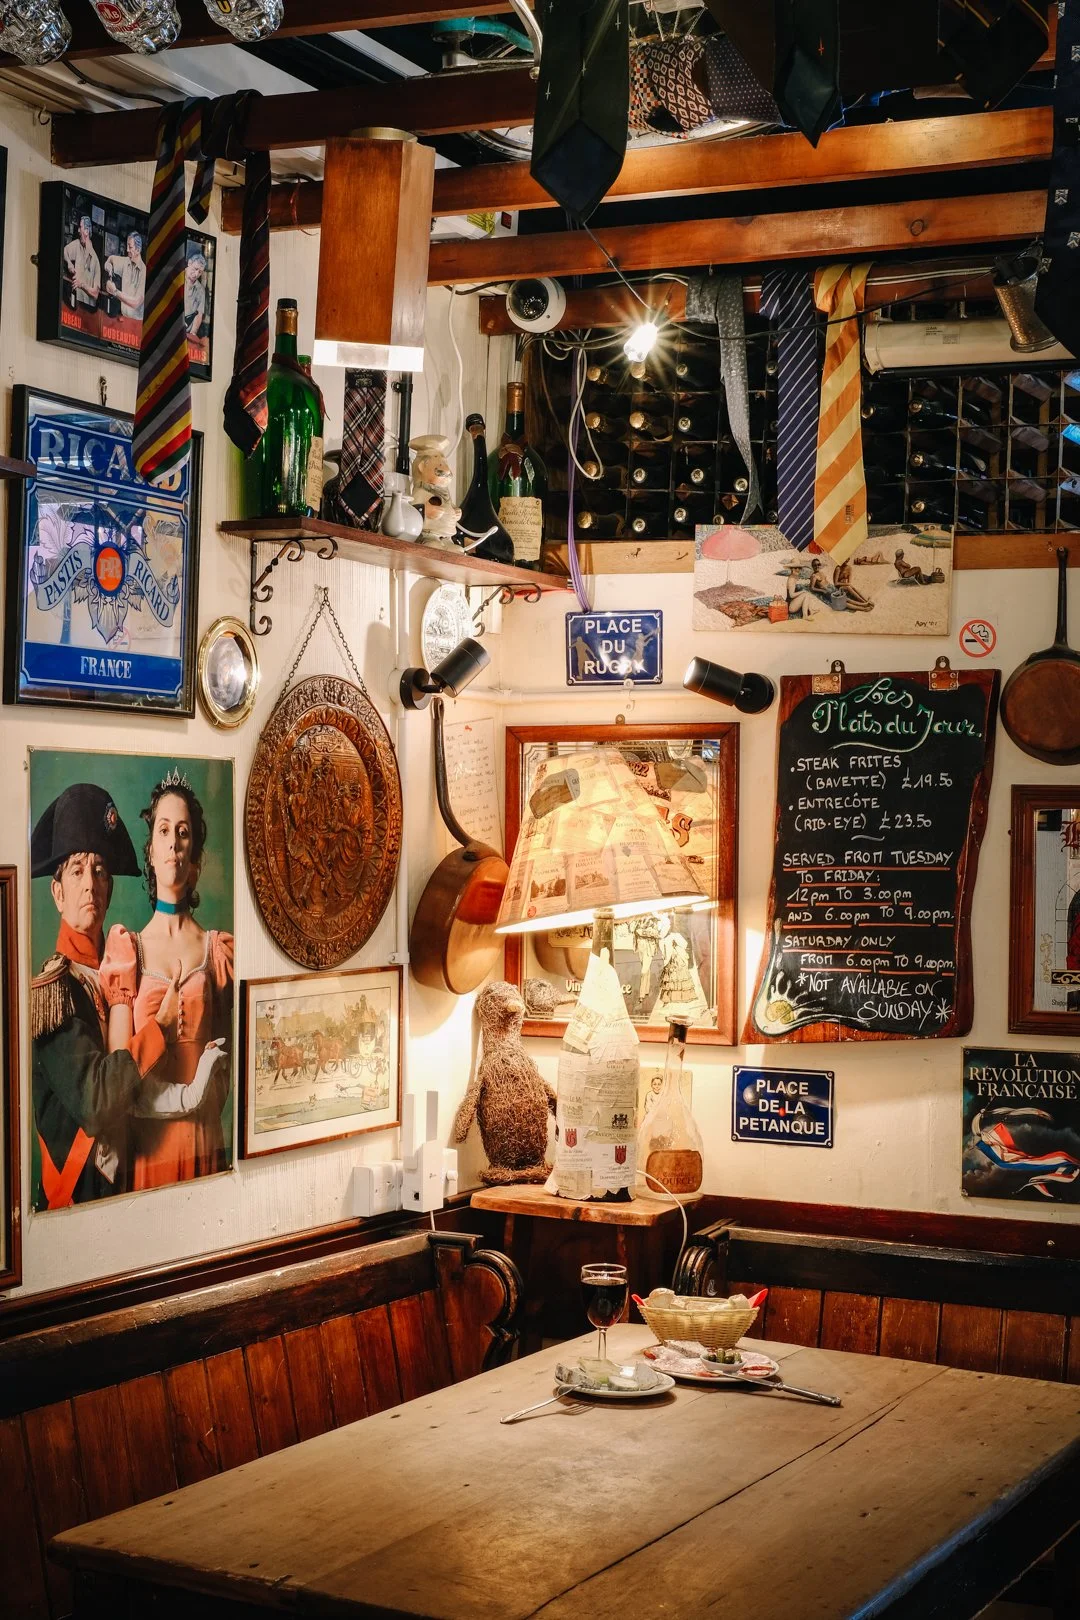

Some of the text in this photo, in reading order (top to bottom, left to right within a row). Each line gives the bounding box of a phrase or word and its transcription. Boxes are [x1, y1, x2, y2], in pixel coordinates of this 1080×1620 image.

[38, 428, 182, 491] RICAD
[44, 550, 83, 606] PASTIS
[134, 560, 170, 621] RICARD
[584, 619, 642, 634] PLACE
[601, 640, 625, 654] DU
[80, 656, 132, 679] FRANCE
[584, 659, 644, 675] RUGBY
[854, 677, 913, 709] Les
[811, 699, 882, 734] Plats
[886, 714, 917, 734] du
[797, 755, 902, 771] STEAK FRITES
[783, 851, 953, 866] SERVED FROM TUESDAY
[787, 888, 829, 906] 12pm
[788, 912, 812, 922] AND
[783, 935, 896, 948] SATURDAY ONLY
[800, 953, 833, 965] FROM
[894, 955, 909, 967] TO
[914, 980, 943, 996] ON
[1014, 1053, 1038, 1068] LA
[969, 1065, 1080, 1084] RÉVOLUTION
[756, 1079, 809, 1096] PLACE
[977, 1082, 1077, 1100] FRANÇAISE
[758, 1099, 806, 1115] DE LA
[739, 1117, 825, 1135] PETANQUE
